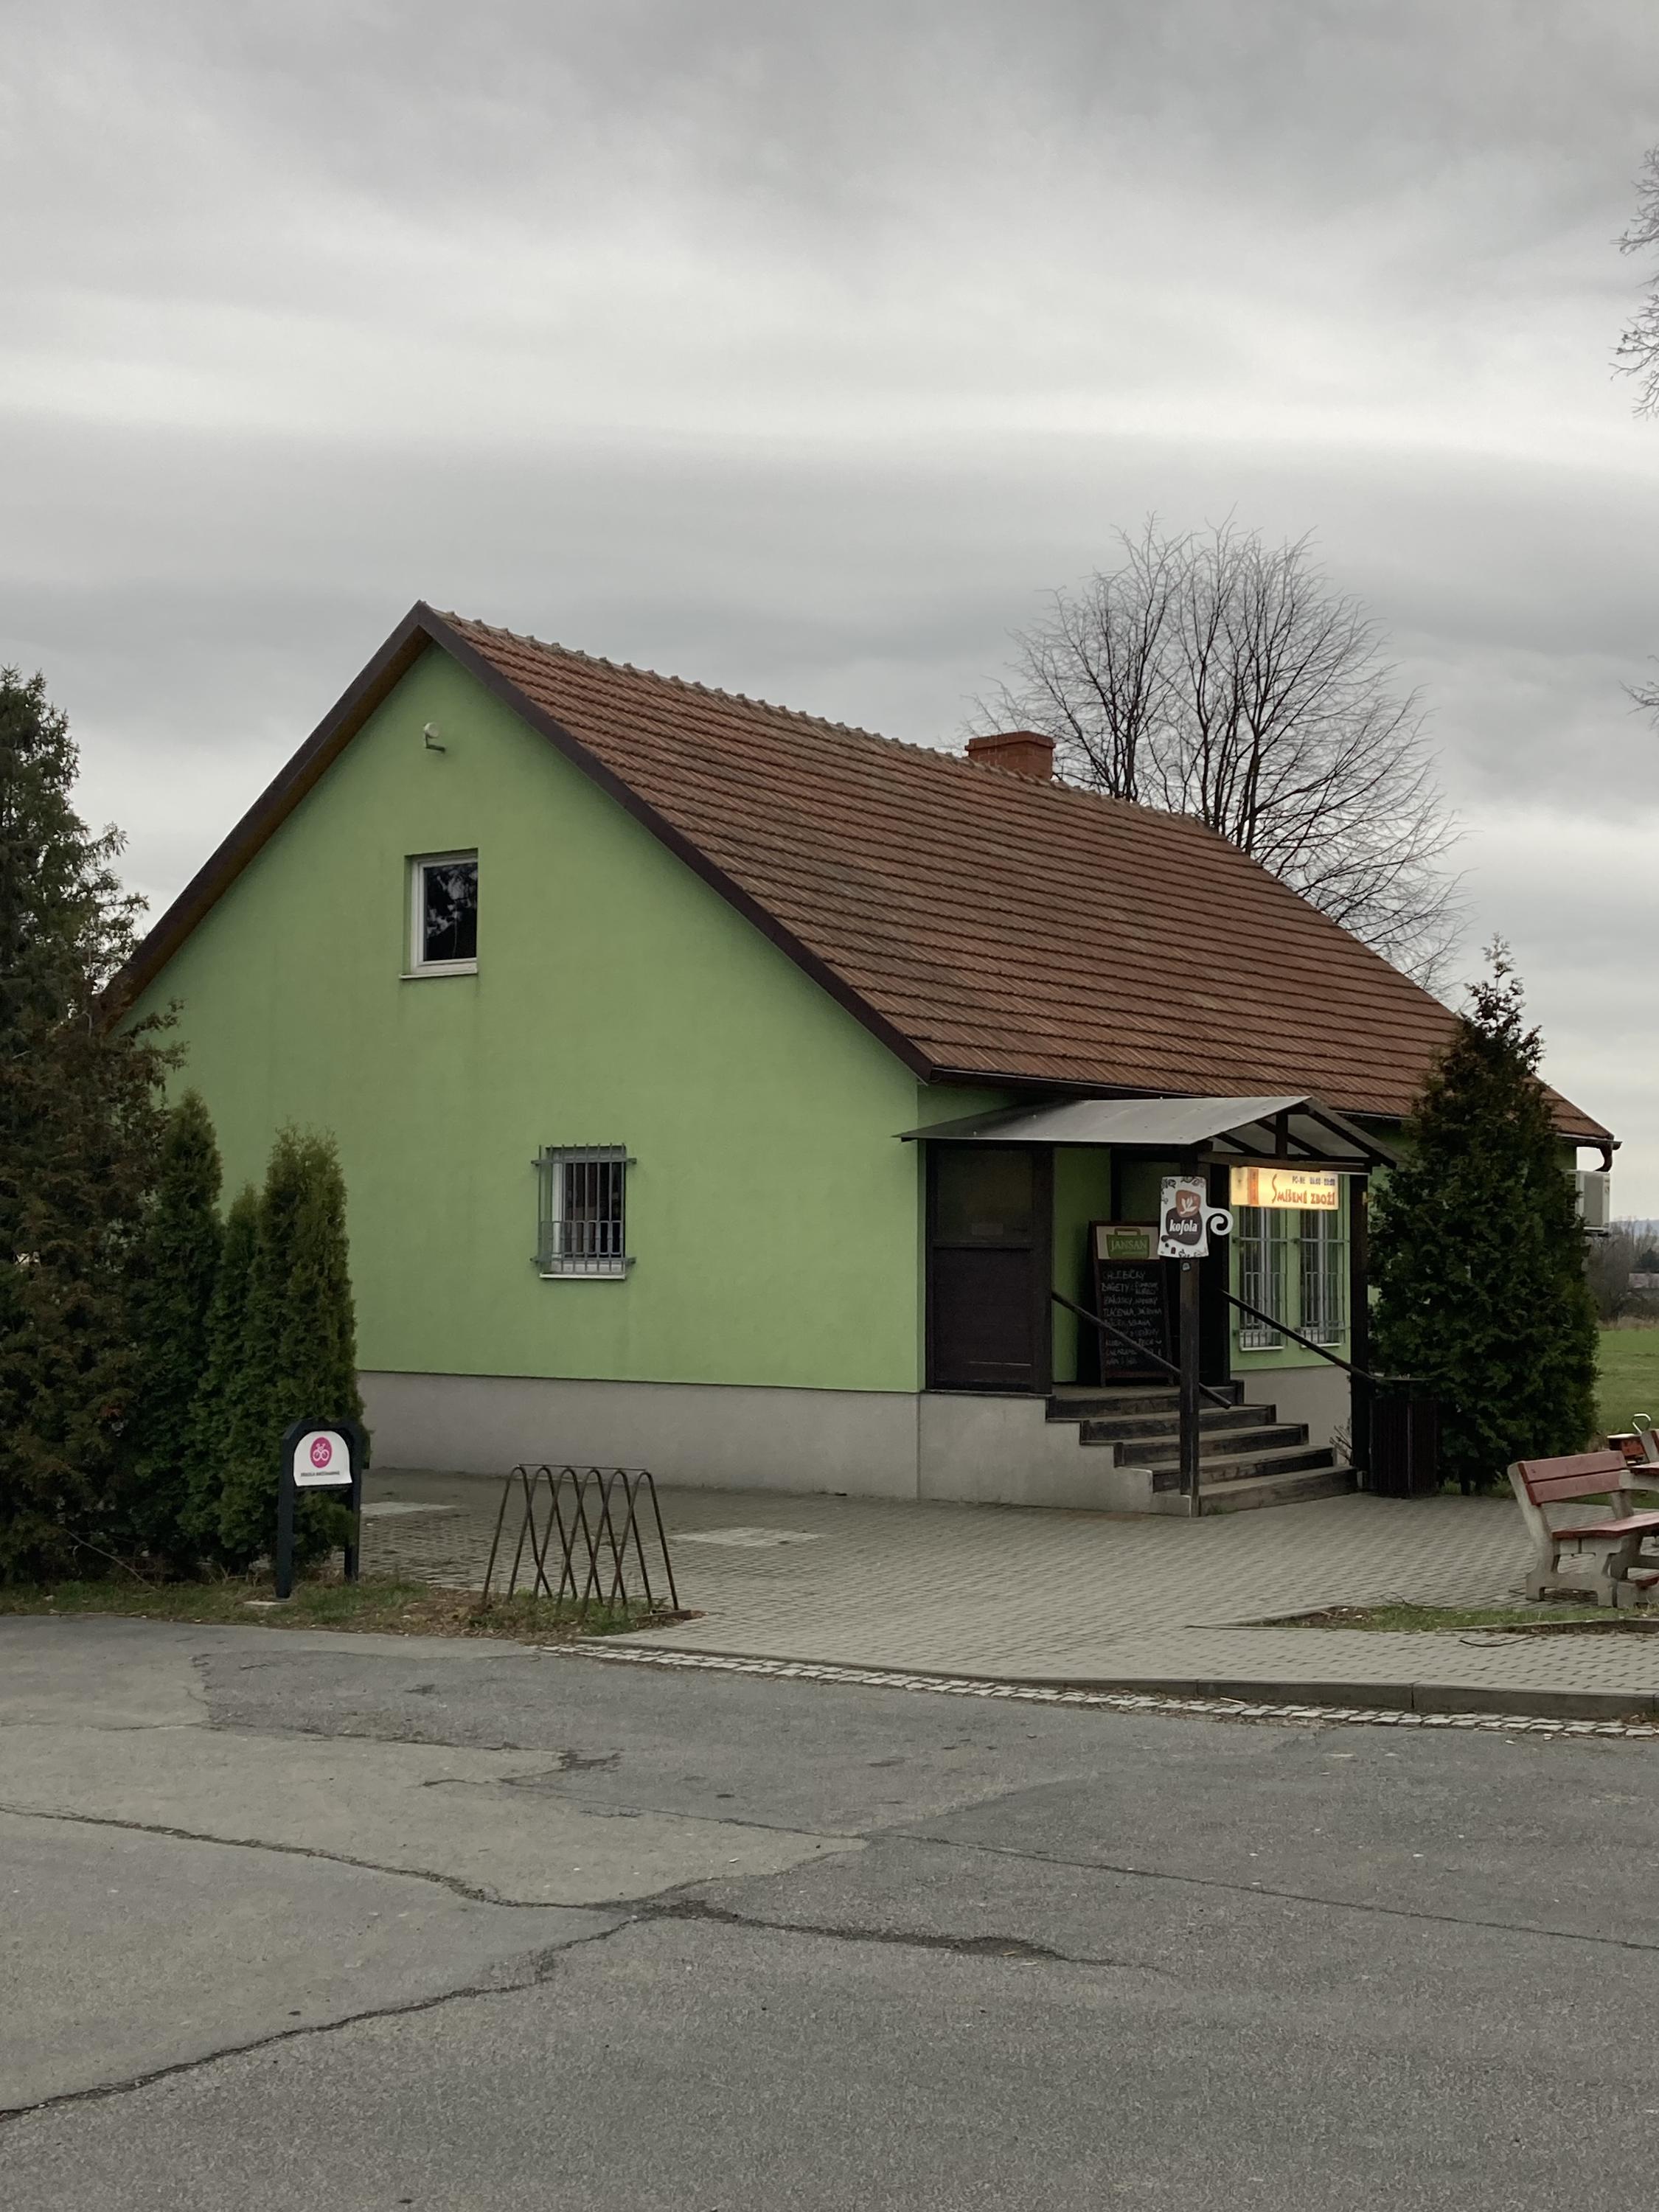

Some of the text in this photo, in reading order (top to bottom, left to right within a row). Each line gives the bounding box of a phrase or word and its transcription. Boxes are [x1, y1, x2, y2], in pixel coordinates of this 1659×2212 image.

[1310, 1192, 1335, 1206] ZBOŽÍ
[1169, 1219, 1197, 1235] kofola
[1110, 1239, 1146, 1253] JANSAN
